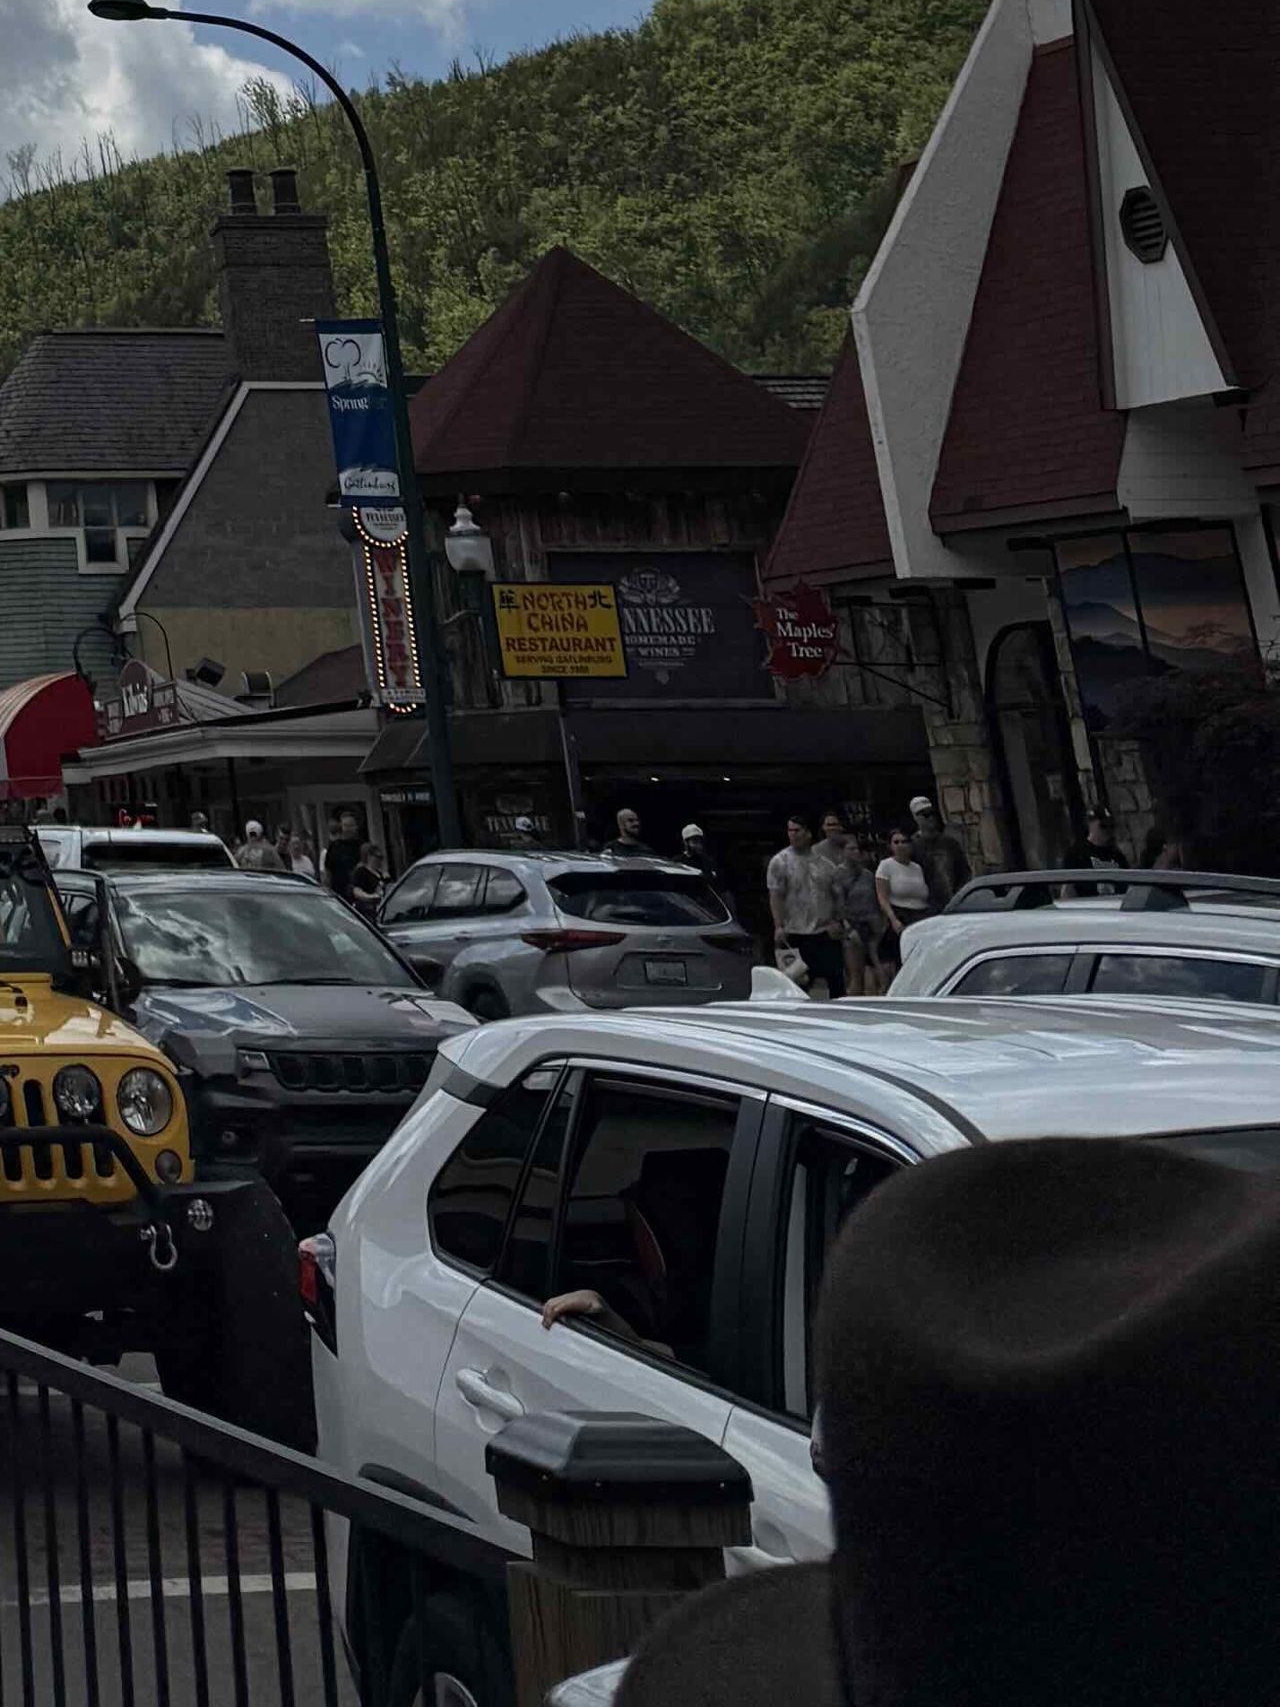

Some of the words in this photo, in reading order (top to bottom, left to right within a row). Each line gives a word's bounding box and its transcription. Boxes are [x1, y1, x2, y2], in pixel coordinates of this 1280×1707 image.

[522, 590, 587, 610] NORTH
[528, 612, 588, 633] CHINA
[776, 608, 799, 621] The
[505, 636, 616, 652] RESTAURANT
[789, 641, 825, 659] Tree
